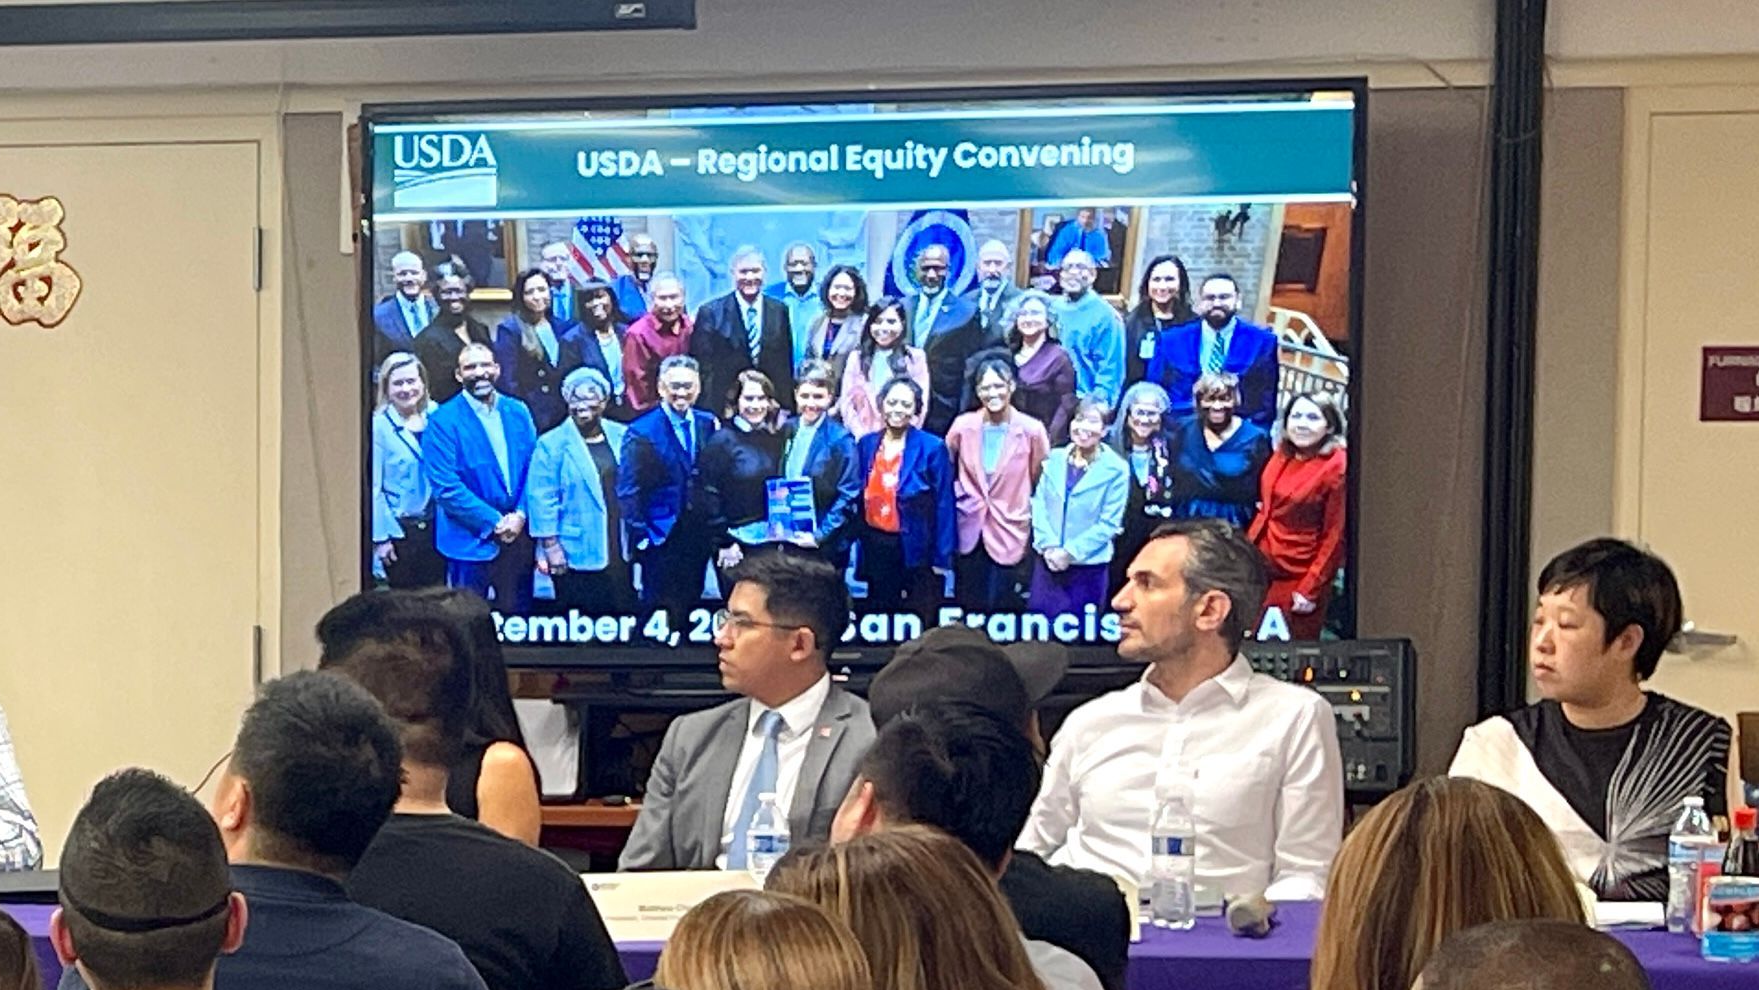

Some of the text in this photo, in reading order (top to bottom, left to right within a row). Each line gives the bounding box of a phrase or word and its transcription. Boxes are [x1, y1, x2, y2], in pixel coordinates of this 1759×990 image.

[393, 133, 497, 169] USDA
[577, 150, 665, 178] USDA
[697, 143, 839, 182] Regional
[846, 140, 948, 179] Equity
[953, 136, 1135, 175] Convening
[643, 609, 681, 647] 4,
